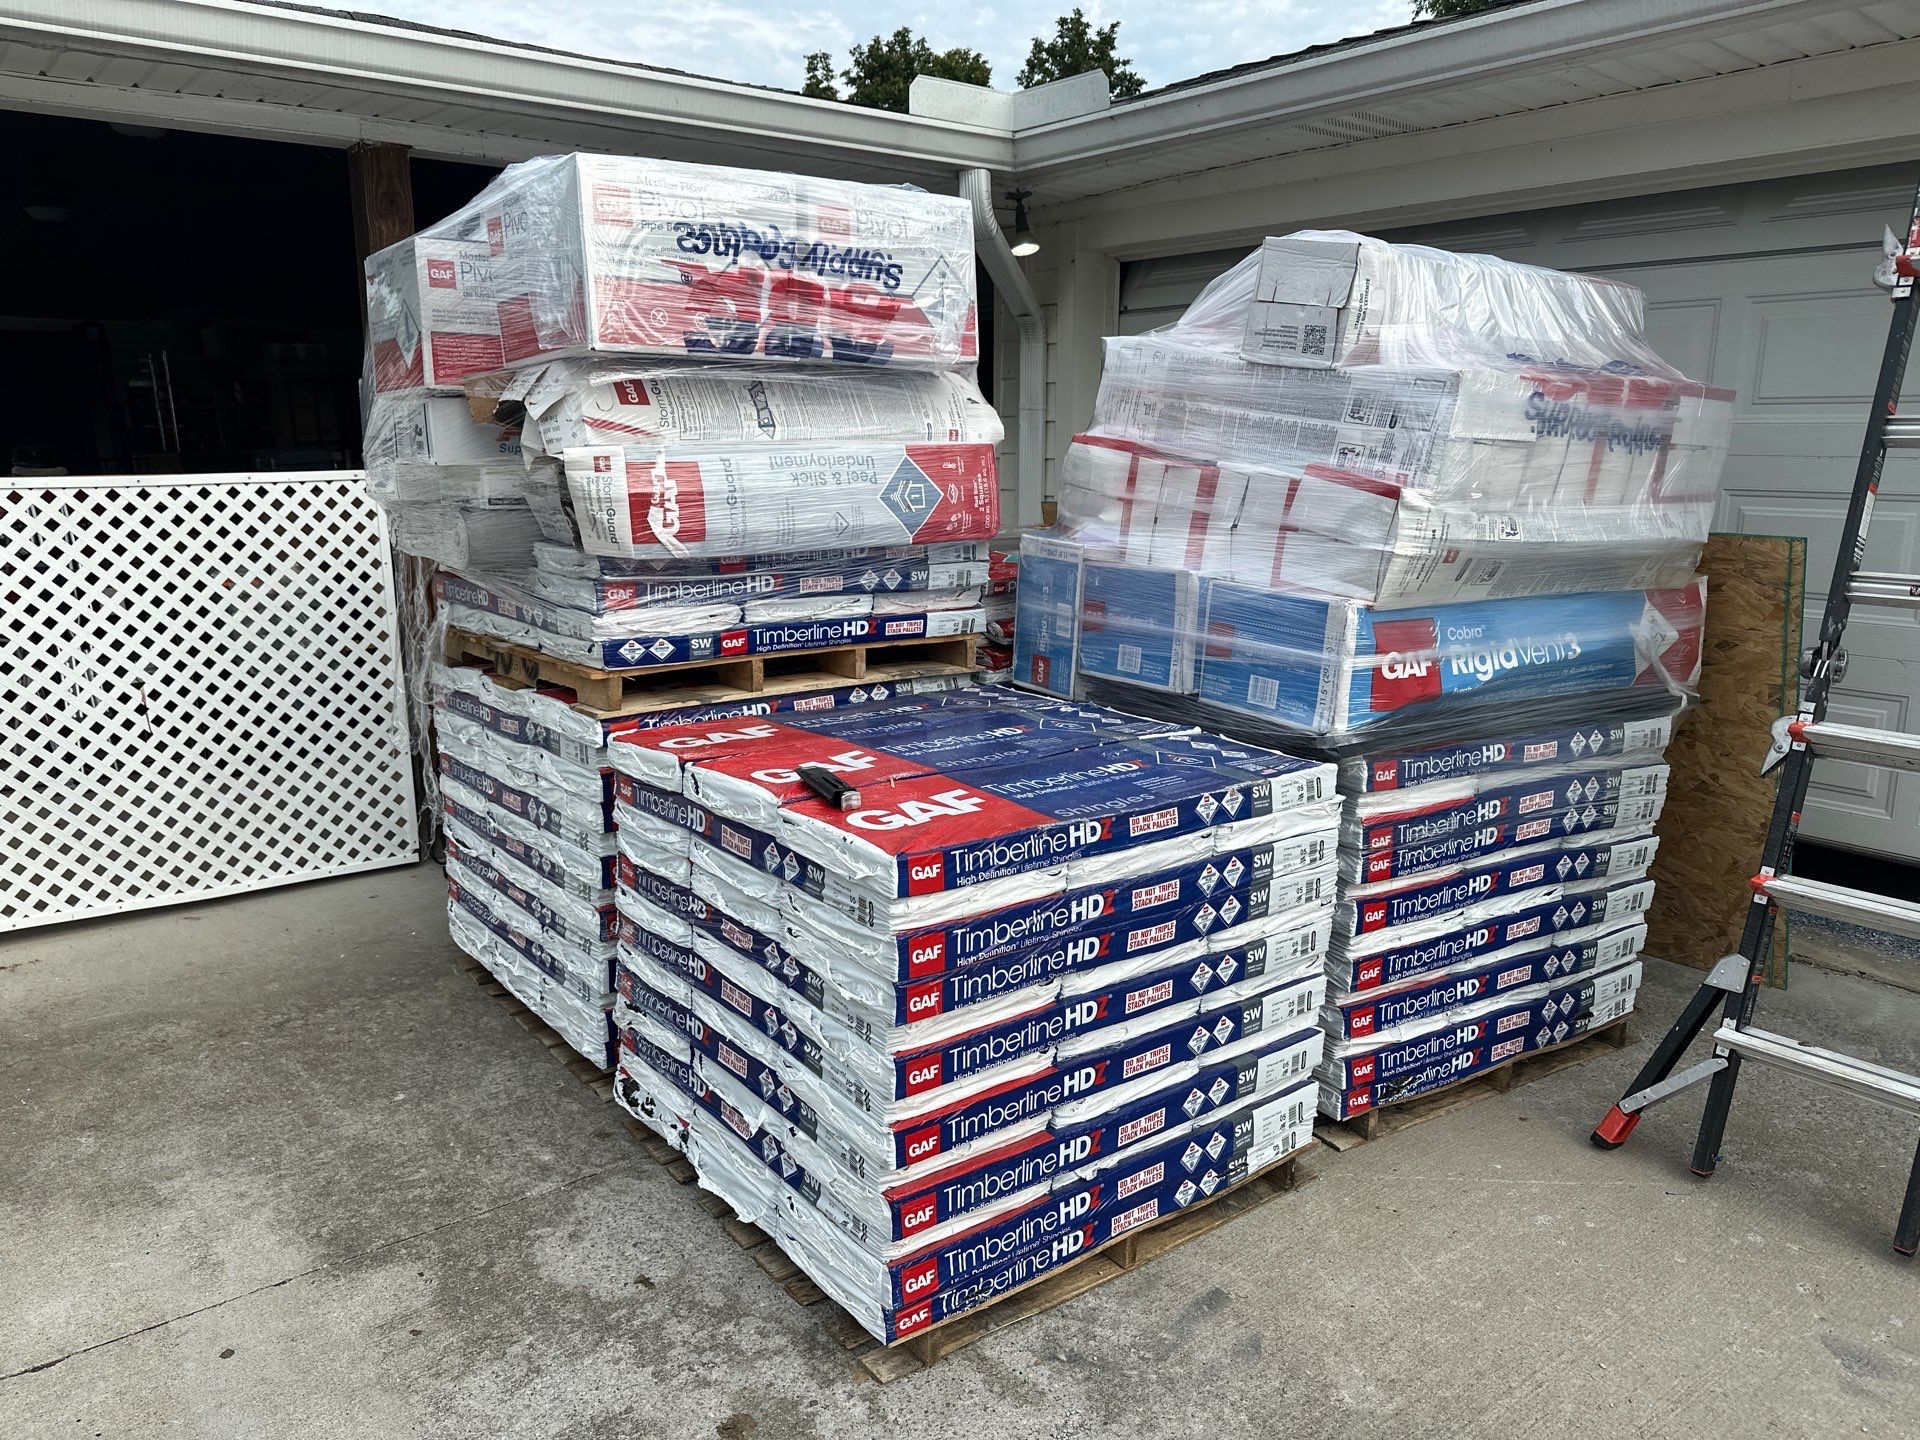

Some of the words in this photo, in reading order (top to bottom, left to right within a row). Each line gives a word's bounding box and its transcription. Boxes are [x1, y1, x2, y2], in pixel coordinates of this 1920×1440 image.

[430, 268, 454, 280] GAF
[769, 453, 876, 471] Underlayment
[790, 473, 827, 486] Stick
[831, 471, 842, 485] &
[847, 471, 878, 485] Peel
[911, 570, 928, 582] SW
[608, 589, 633, 600] GAF
[1447, 626, 1483, 641] Cobra
[691, 638, 712, 649] SW
[722, 638, 746, 649] GAF
[1382, 650, 1434, 682] GAF
[896, 683, 911, 692] SW
[659, 724, 779, 749] GAF
[1610, 729, 1624, 740] SW
[751, 751, 878, 783] GAF
[1376, 769, 1396, 782] GAF
[1607, 777, 1621, 788] SW
[1252, 785, 1271, 799] SW
[846, 789, 986, 830] GAF
[1053, 792, 1156, 817] Shingles
[1604, 805, 1618, 815] SW
[1131, 816, 1140, 826] DO
[1142, 814, 1154, 824] NOT
[1156, 809, 1176, 821] TRIPLE
[1131, 823, 1151, 835] STACK
[1152, 817, 1177, 831] PALLETS
[1371, 835, 1391, 848] GAF
[1254, 851, 1273, 868] SW
[1370, 859, 1390, 872] GAF
[1596, 852, 1610, 862] SW
[808, 864, 823, 882] SW
[912, 863, 941, 881] GAF
[957, 874, 977, 887] High
[1052, 851, 1082, 865] Shingles
[1134, 890, 1142, 899] DO
[1144, 887, 1156, 898] NOT
[1159, 881, 1178, 894] TRIPLE
[1250, 889, 1269, 906] SW
[1133, 897, 1153, 909] STACK
[1154, 890, 1178, 904] PALLETS
[1593, 899, 1607, 910] SW
[1365, 910, 1385, 922] GAF
[1129, 938, 1148, 950] STACK
[1149, 931, 1174, 946] PALLETS
[1130, 932, 1139, 941] DO
[1140, 928, 1153, 938] NOT
[1155, 922, 1175, 935] TRIPLE
[912, 944, 942, 964] GAF
[1247, 946, 1266, 963] SW
[1583, 947, 1597, 959] SW
[1360, 967, 1380, 980] GAF
[1127, 993, 1136, 1001] DO
[1137, 989, 1149, 999] NOT
[1152, 982, 1171, 995] TRIPLE
[1127, 999, 1146, 1011] STACK
[1147, 990, 1171, 1006] PALLETS
[1581, 987, 1594, 999] SW
[909, 991, 940, 1013] GAF
[1243, 1006, 1262, 1024] SW
[1352, 1015, 1372, 1028] GAF
[1125, 1058, 1134, 1067] DO
[1135, 1054, 1147, 1064] NOT
[1150, 1046, 1169, 1060] TRIPLE
[1125, 1064, 1144, 1076] STACK
[1145, 1054, 1169, 1071] PALLETS
[909, 1064, 940, 1085] GAF
[1238, 1067, 1257, 1084] SW
[1354, 1063, 1373, 1077] GAF
[1119, 1132, 1139, 1144] STACK
[1140, 1118, 1163, 1137] PALLETS
[1120, 1126, 1129, 1135] DO
[1130, 1121, 1142, 1131] NOT
[1144, 1110, 1164, 1126] TRIPLE
[1235, 1119, 1253, 1137] SW
[908, 1136, 937, 1157] GAF
[805, 1170, 820, 1192] SW
[1119, 1180, 1128, 1189] DO
[1129, 1175, 1141, 1185] NOT
[1143, 1164, 1163, 1180] TRIPLE
[1119, 1186, 1138, 1198] STACK
[1138, 1172, 1163, 1191] PALLETS
[904, 1206, 934, 1228] GAF
[1123, 1211, 1135, 1221] NOT
[1137, 1200, 1156, 1216] TRIPLE
[1132, 1209, 1157, 1227] PALLETS
[905, 1271, 935, 1293] GAF
